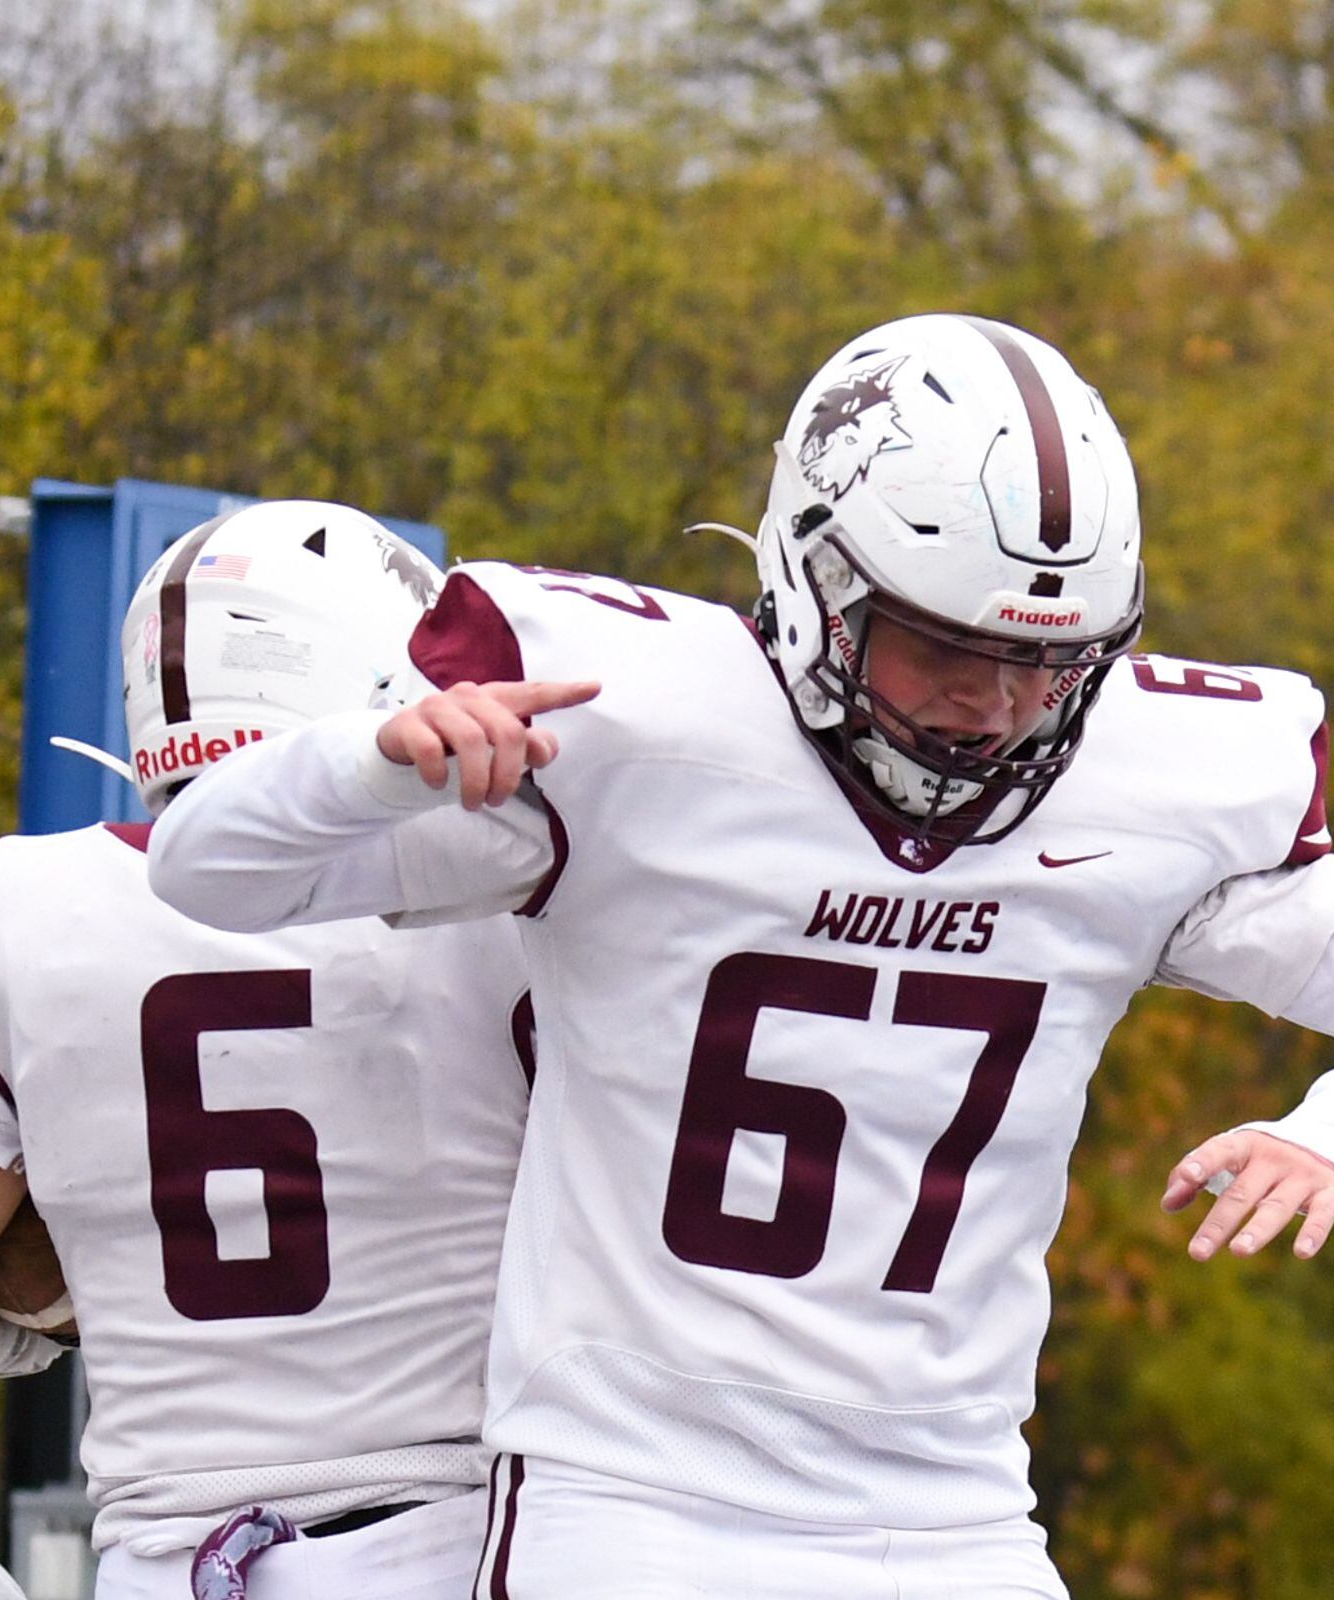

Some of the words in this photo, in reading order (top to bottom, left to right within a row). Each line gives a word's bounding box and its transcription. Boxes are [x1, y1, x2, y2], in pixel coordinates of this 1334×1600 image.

[1043, 646, 1097, 711] Riddll
[804, 889, 1000, 954] WOLVES
[140, 968, 331, 1322] 6
[661, 951, 1048, 1294] 67
